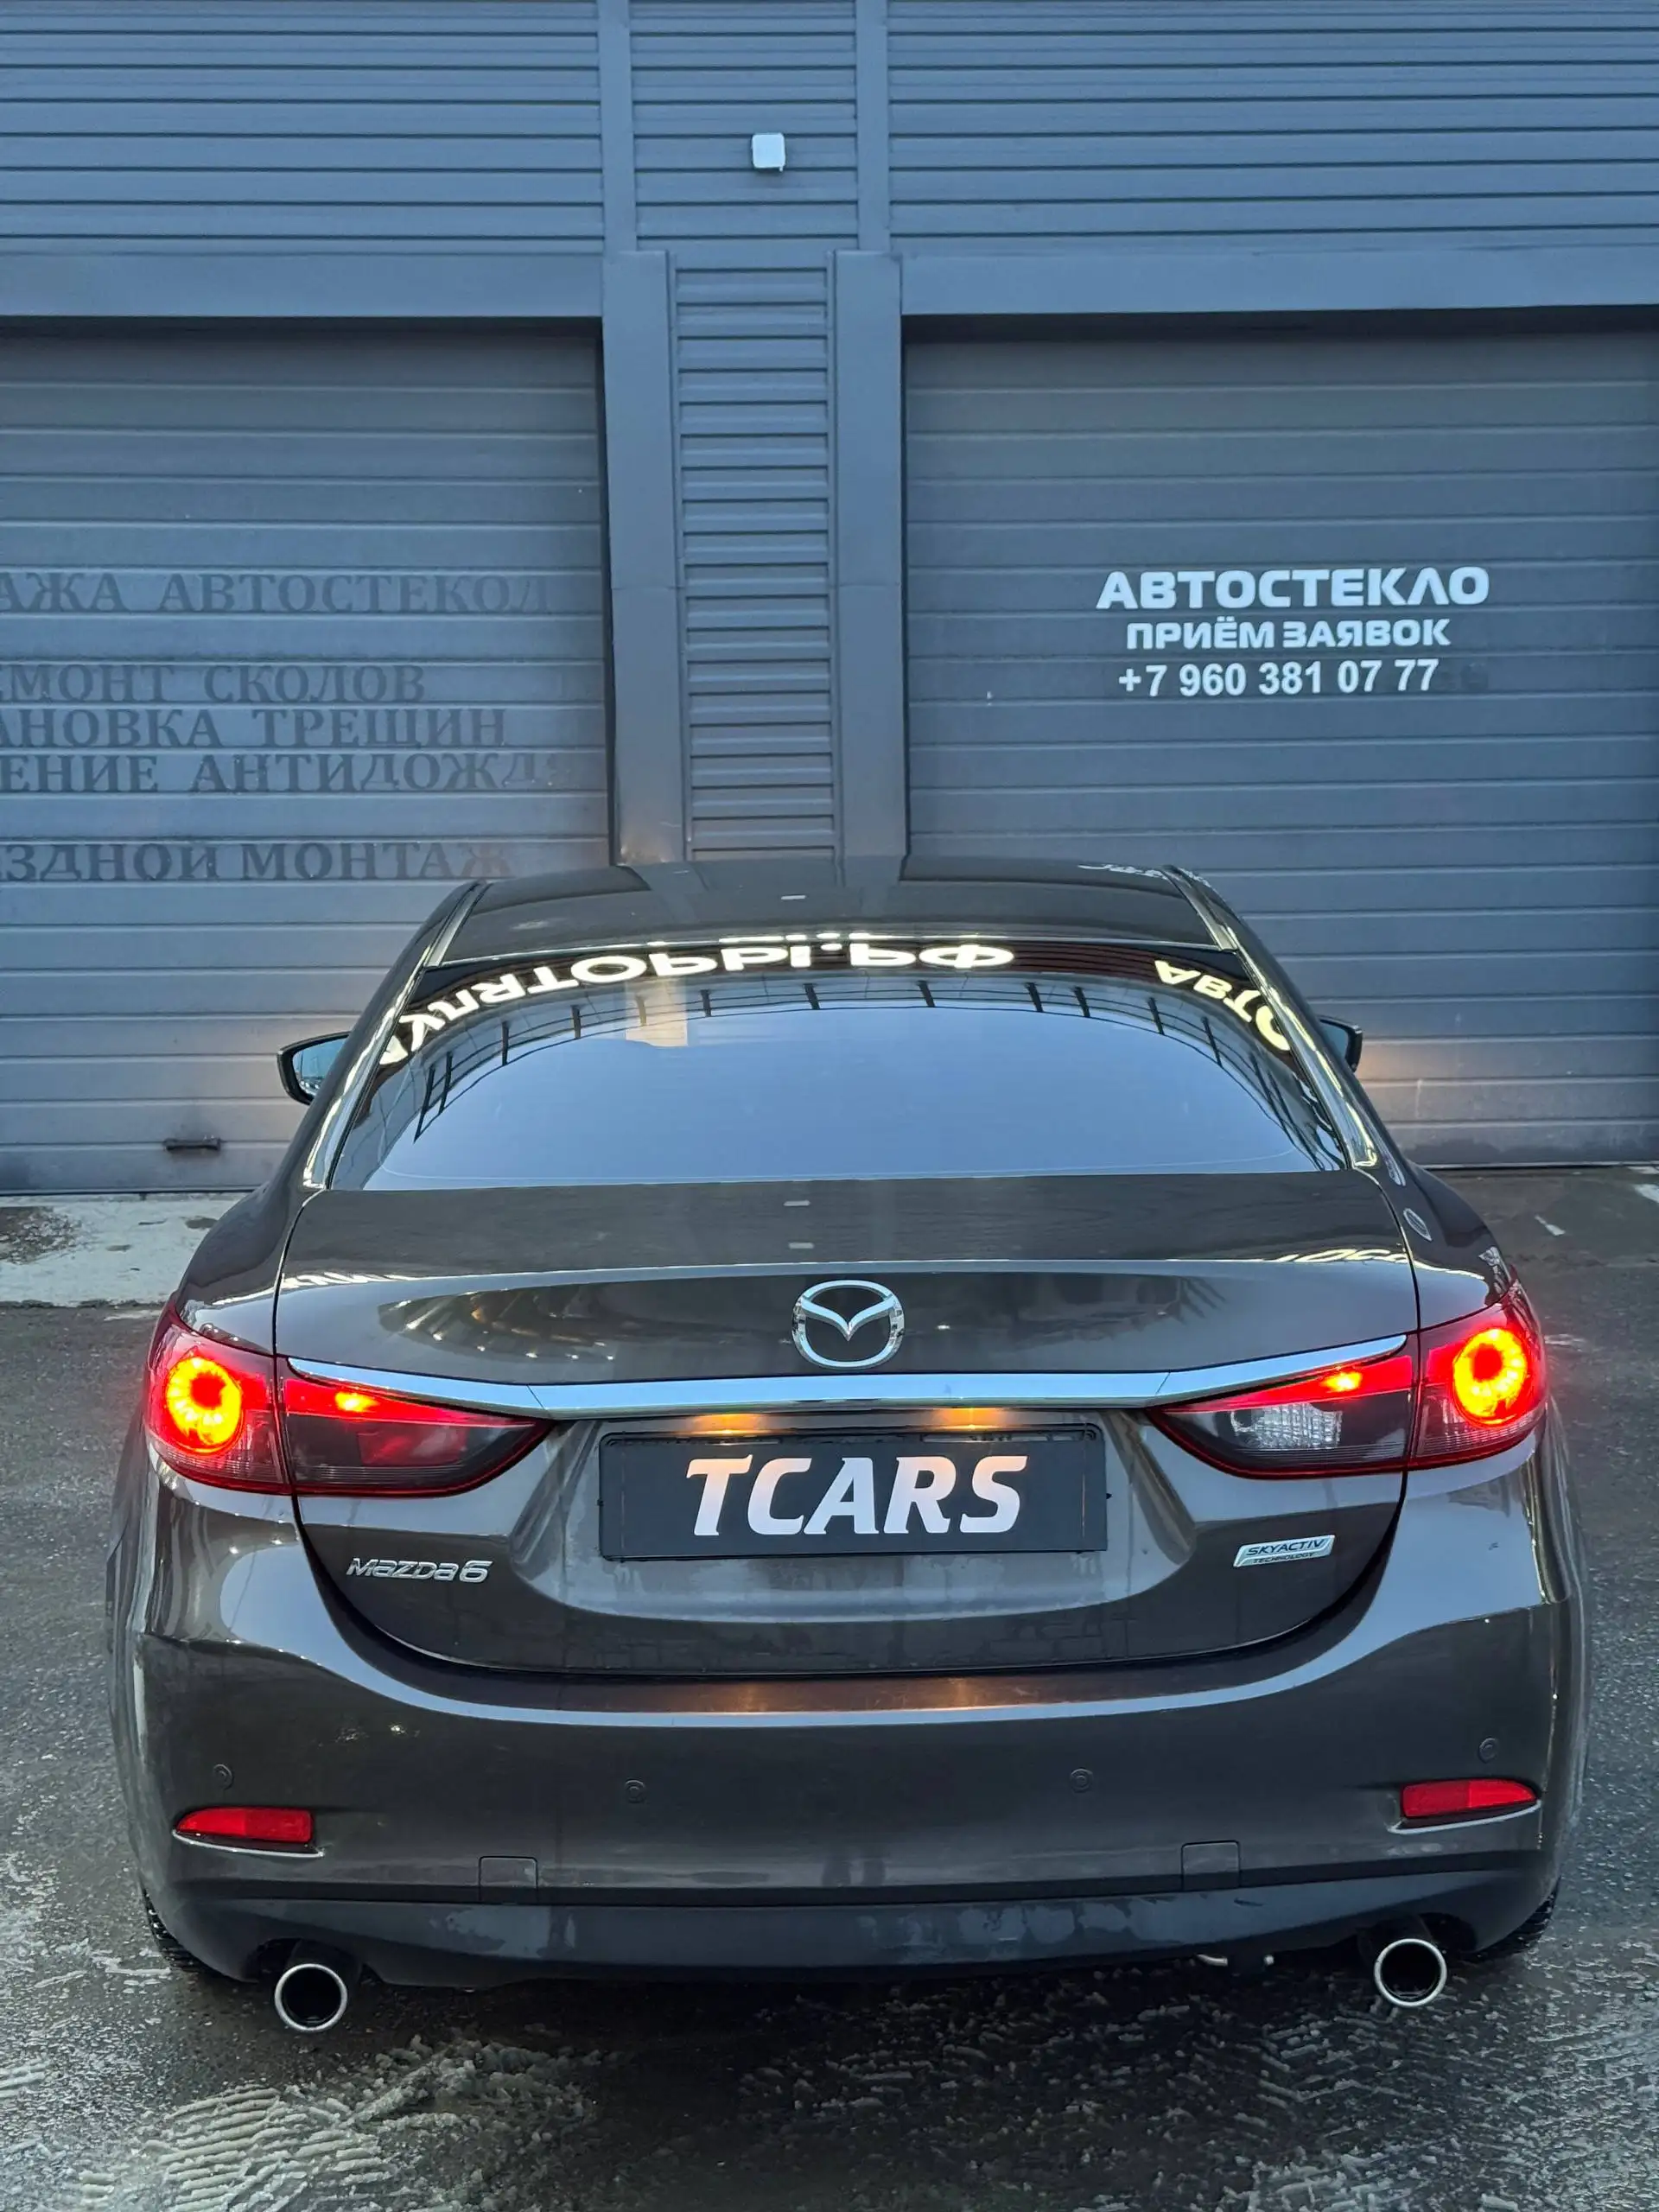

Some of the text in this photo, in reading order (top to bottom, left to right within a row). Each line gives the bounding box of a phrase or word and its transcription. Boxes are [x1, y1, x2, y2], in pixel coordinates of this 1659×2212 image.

[1096, 566, 1490, 610] АВТОСТЕКЛО
[1127, 615, 1452, 650] ПРИЁМ ЗАЯВОК
[0, 663, 426, 704] МОНТ СКОЛОВ
[1118, 658, 1440, 696] +7 960 381 07 77
[251, 709, 507, 749] ТРЕЩИН
[188, 753, 567, 793] АНТИДОЖД
[0, 841, 219, 881] ЗДНОЙ
[686, 1454, 1027, 1536] TCARS
[1247, 1539, 1325, 1556] SKYACTIV
